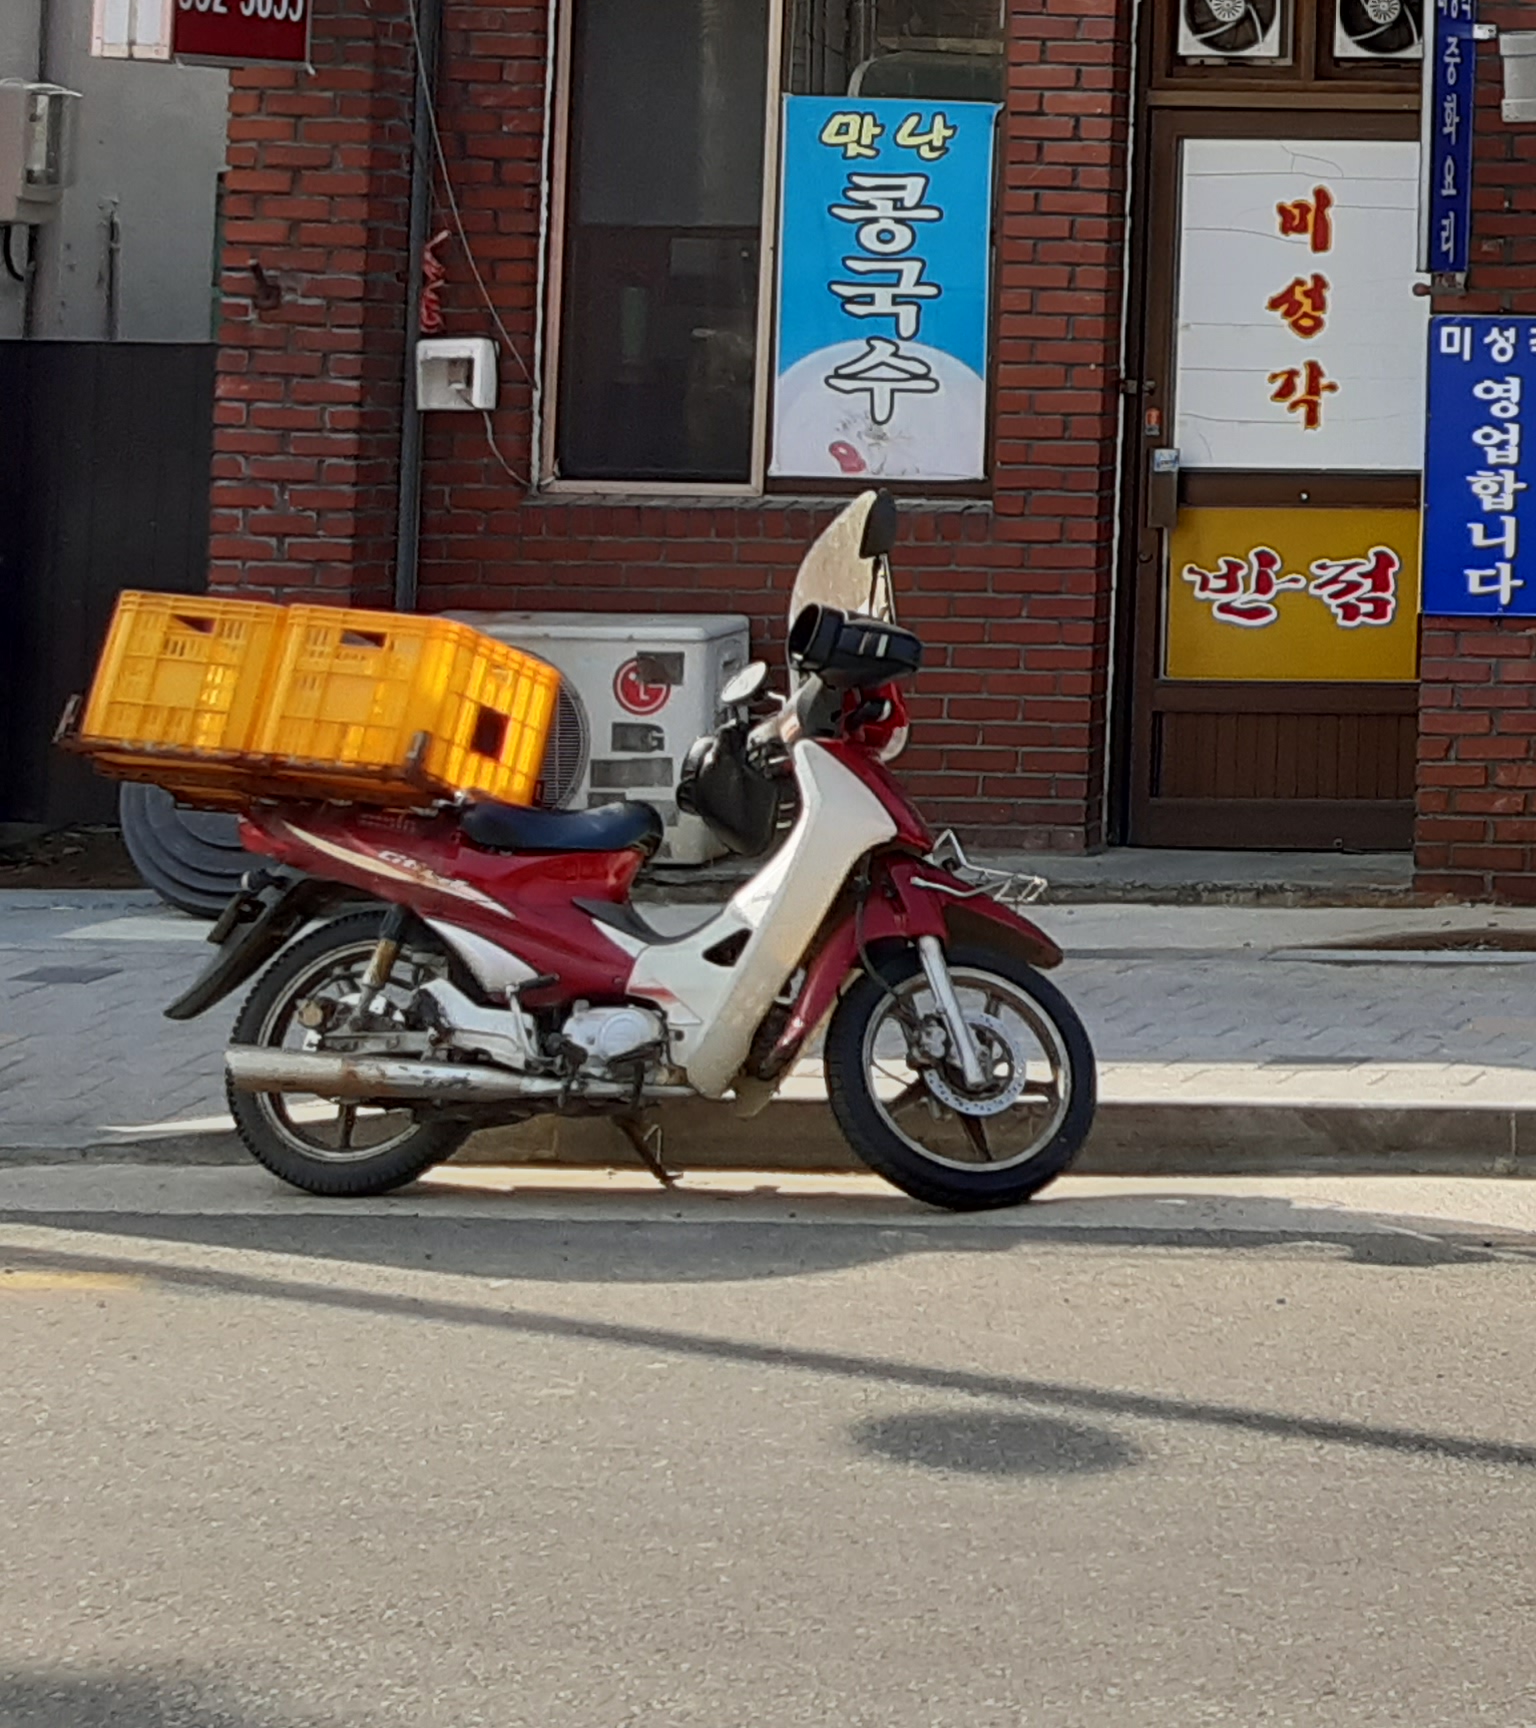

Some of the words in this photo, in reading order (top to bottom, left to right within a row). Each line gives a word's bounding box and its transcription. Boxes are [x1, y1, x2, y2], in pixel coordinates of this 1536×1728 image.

[820, 111, 957, 160] 맛난
[824, 173, 944, 424] 콩국수
[1266, 185, 1340, 430] 미성각
[1183, 545, 1400, 628] 반점
[1464, 376, 1528, 605] 영업합니다
